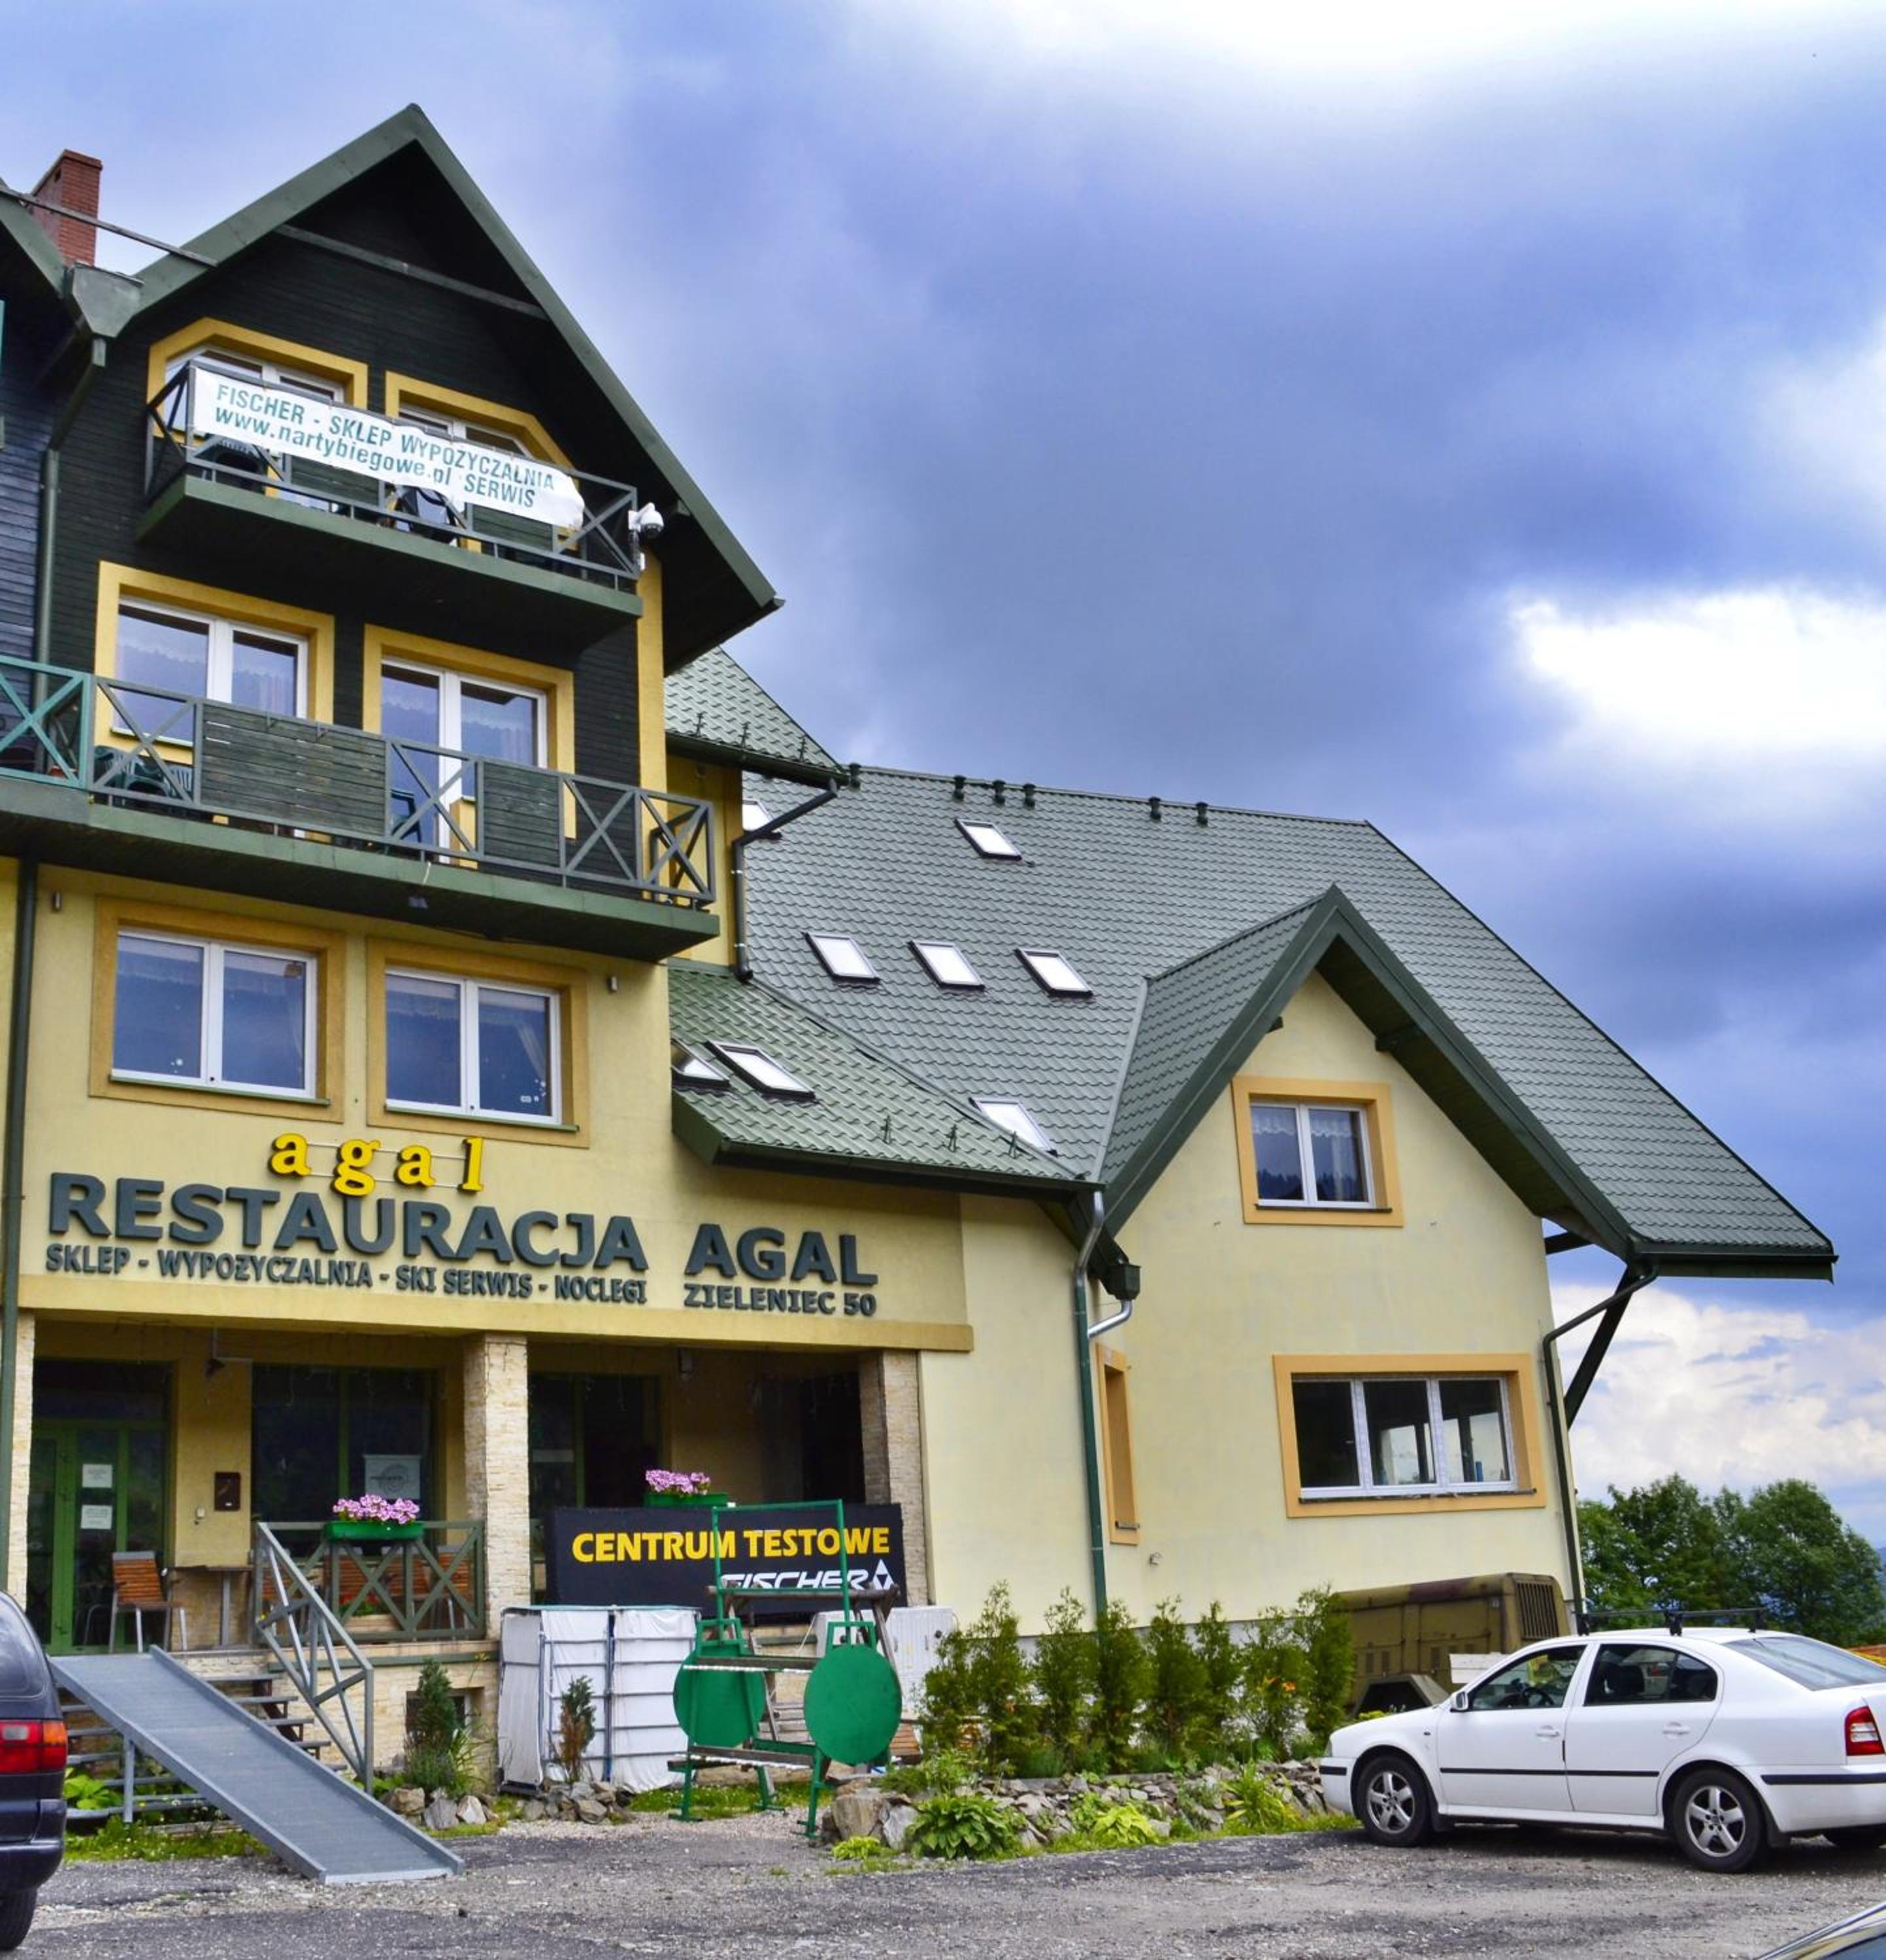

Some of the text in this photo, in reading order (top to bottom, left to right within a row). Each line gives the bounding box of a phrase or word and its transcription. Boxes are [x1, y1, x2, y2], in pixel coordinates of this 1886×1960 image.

[216, 384, 305, 424] FISCHER
[329, 416, 391, 447] SKLEP
[465, 473, 535, 507] SERWIS
[269, 1132, 484, 1196] agal
[49, 1171, 878, 1285] RESTAURACJA AGAL
[46, 1243, 130, 1274] SKLEP
[396, 1265, 437, 1292] SKI
[444, 1269, 533, 1298] SERWIS
[555, 1275, 647, 1304] NOCLEGI
[684, 1283, 876, 1316] ZIELENIEC 50
[572, 1527, 889, 1562] CENTRUM TESTOWE
